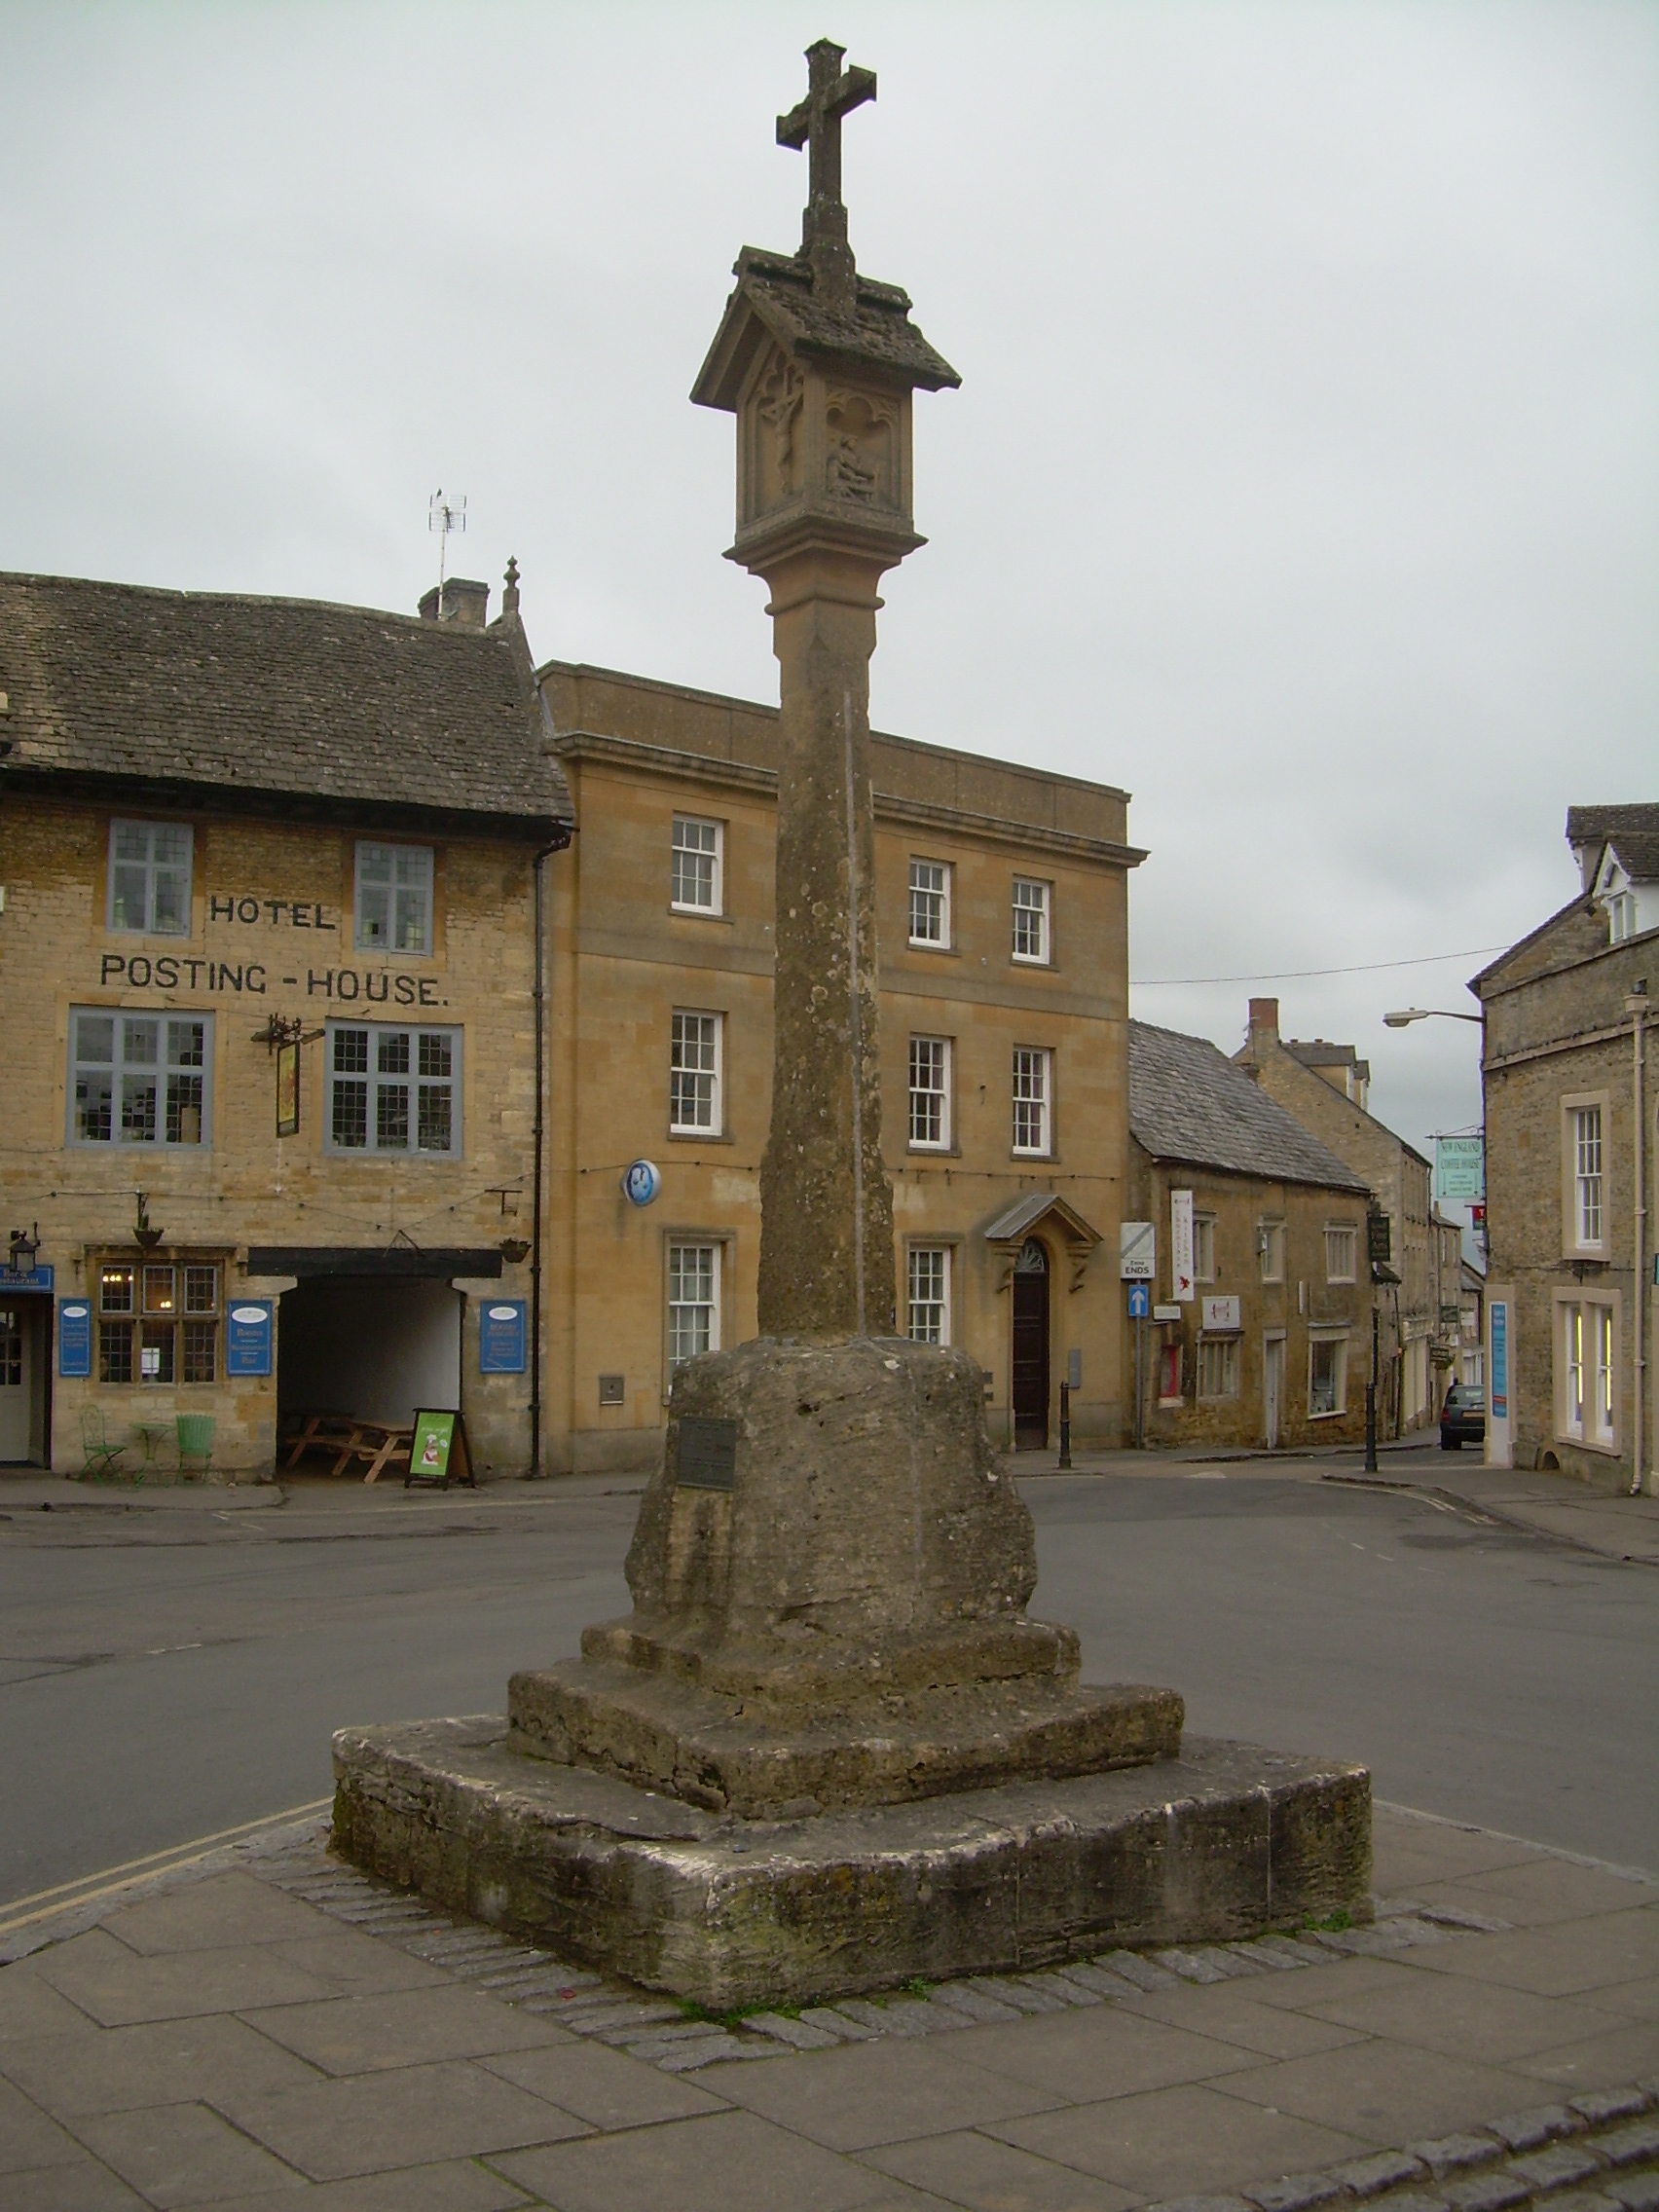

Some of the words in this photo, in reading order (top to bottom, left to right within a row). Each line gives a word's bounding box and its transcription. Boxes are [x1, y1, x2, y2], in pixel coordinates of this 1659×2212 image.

[210, 896, 336, 931] HOTEL
[101, 954, 267, 994] POSTING
[308, 969, 449, 1007] HOUSE.
[1454, 1141, 1481, 1153] ENGLAND
[1124, 1266, 1150, 1274] ENDS
